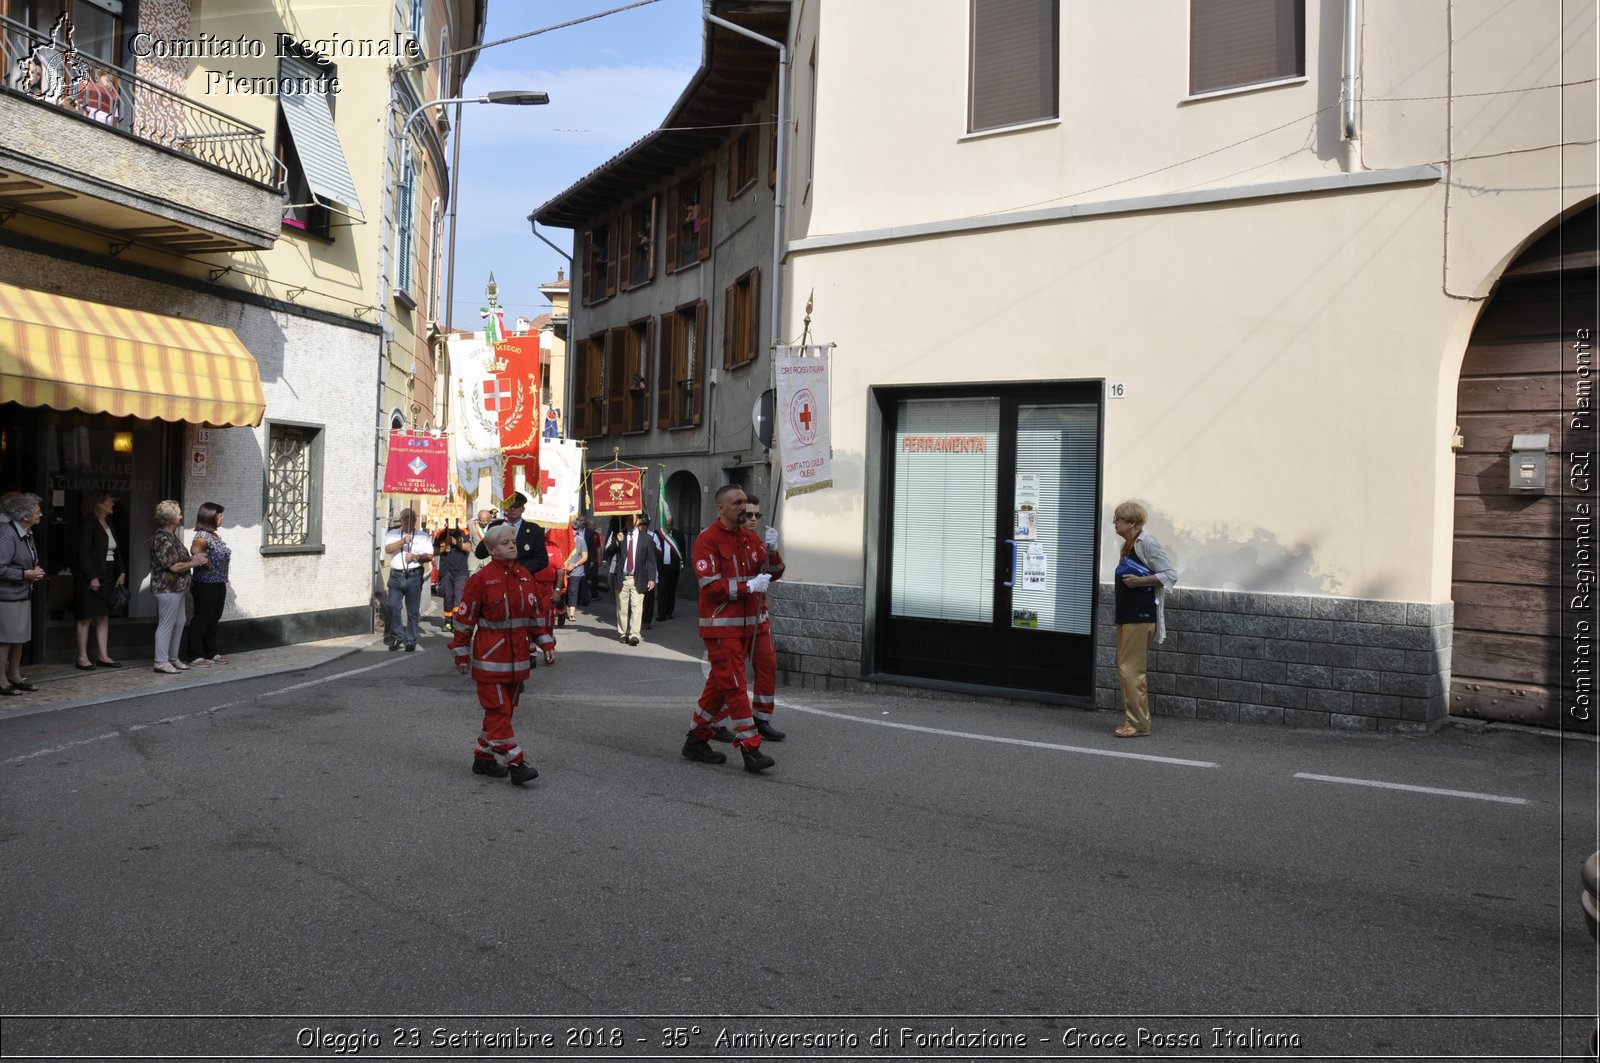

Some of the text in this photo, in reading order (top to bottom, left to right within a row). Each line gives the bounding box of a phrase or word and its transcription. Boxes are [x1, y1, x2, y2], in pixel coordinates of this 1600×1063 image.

[1111, 384, 1123, 396] 16
[200, 431, 209, 441] 15
[902, 433, 986, 454] FERRAMENTA
